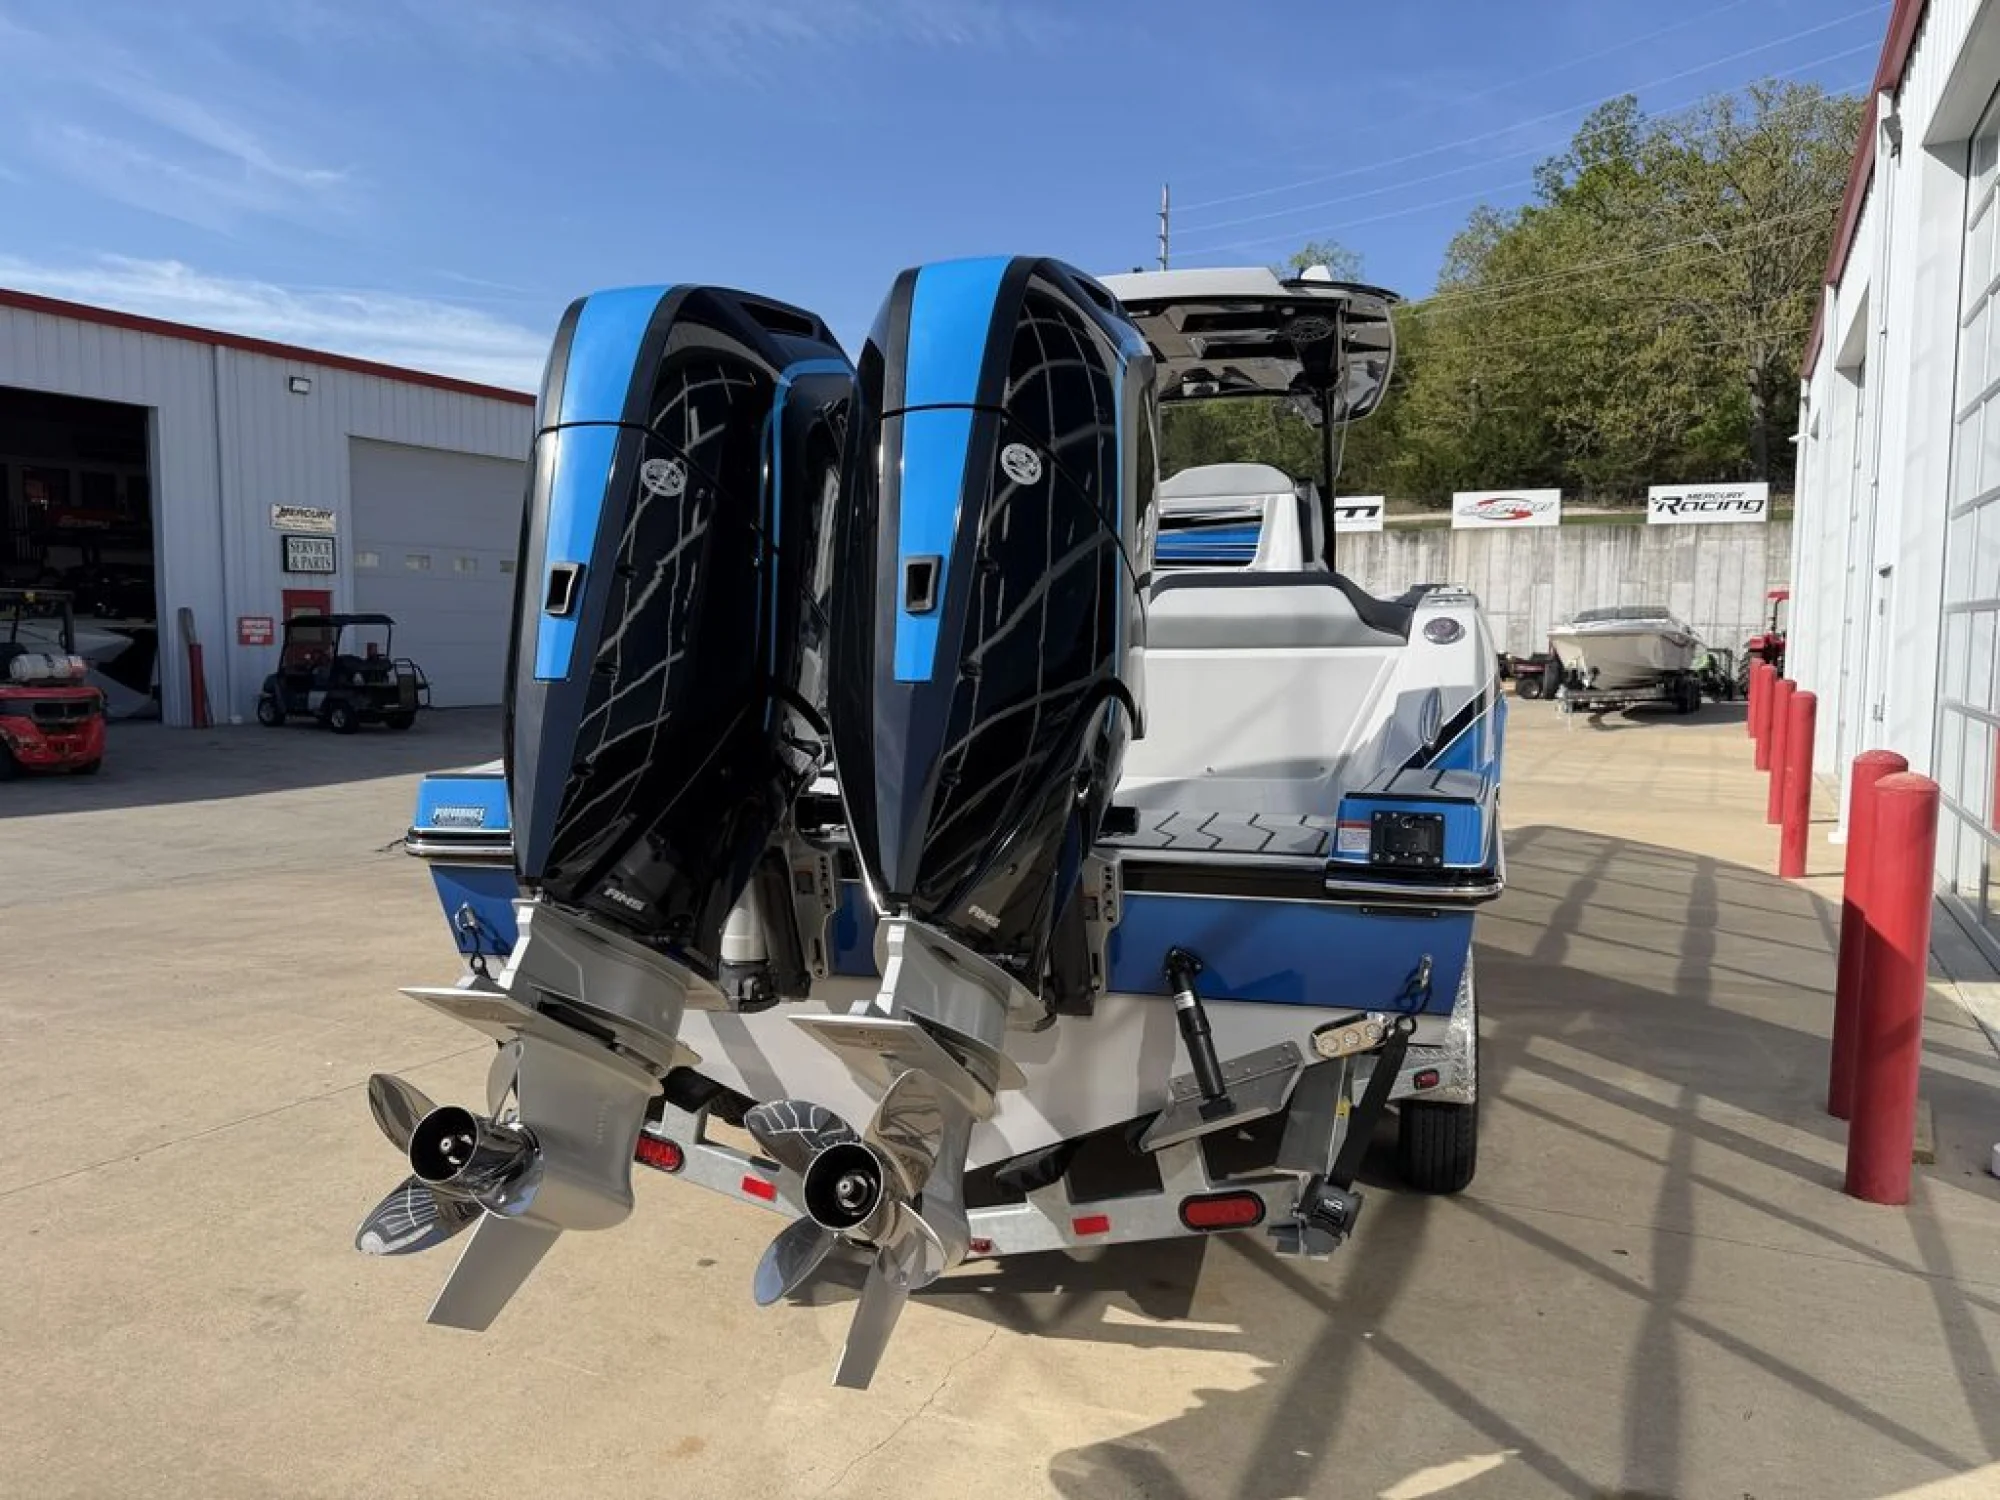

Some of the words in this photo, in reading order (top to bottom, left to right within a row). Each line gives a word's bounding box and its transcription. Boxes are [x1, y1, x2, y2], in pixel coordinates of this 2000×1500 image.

[1686, 491, 1744, 499] MERCURY
[1655, 496, 1764, 515] Racing
[290, 540, 330, 555] SERVICE
[290, 555, 299, 569] &
[301, 556, 331, 570] PARTS
